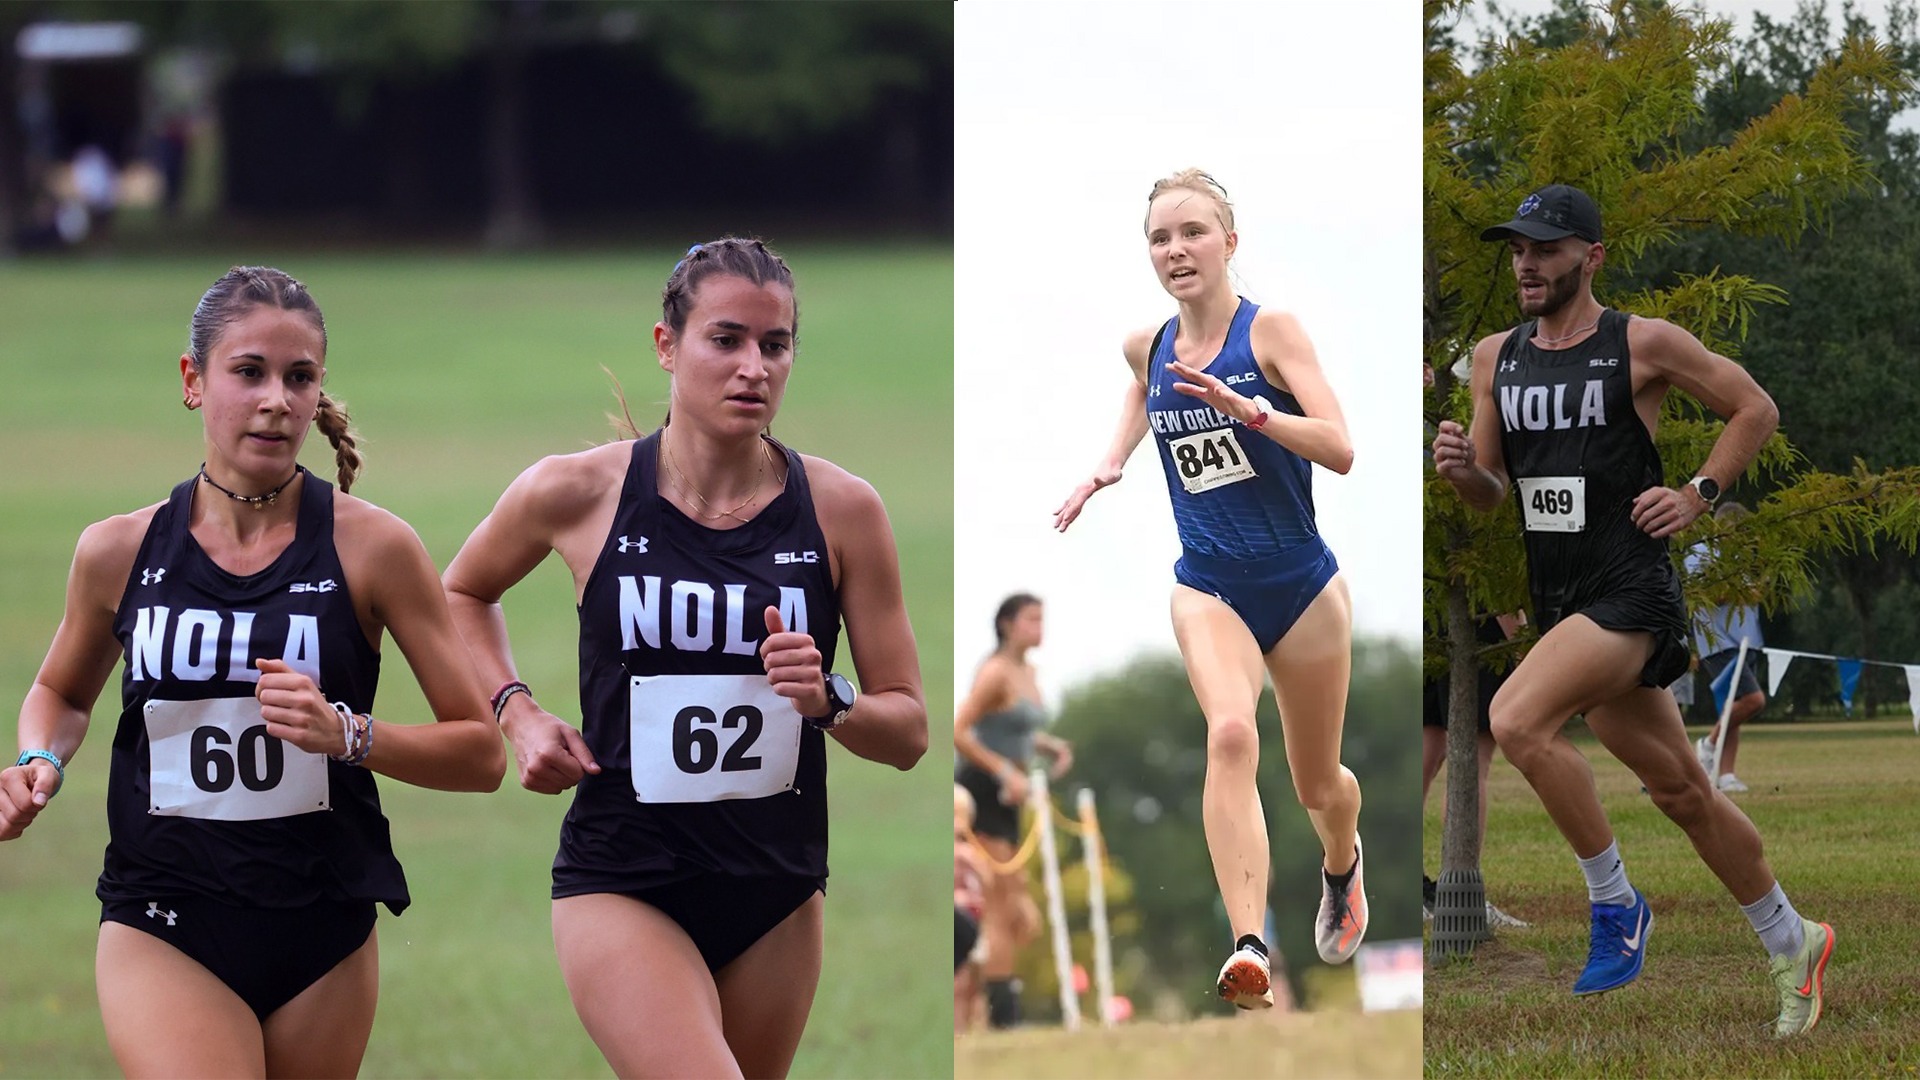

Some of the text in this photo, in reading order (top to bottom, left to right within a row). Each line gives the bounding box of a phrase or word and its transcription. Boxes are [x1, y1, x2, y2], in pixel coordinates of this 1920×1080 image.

[1226, 372, 1256, 385] SLC
[1589, 359, 1618, 367] SLC
[1149, 407, 1245, 434] NEW ORLE
[1501, 380, 1607, 432] NOLA
[1176, 436, 1241, 478] 841
[1532, 490, 1573, 514] 469
[774, 551, 818, 564] SLC
[289, 579, 336, 592] SLC
[618, 575, 809, 656] NOLA
[132, 606, 320, 688] NOLA
[672, 705, 763, 774] 62
[190, 725, 284, 792] 60
